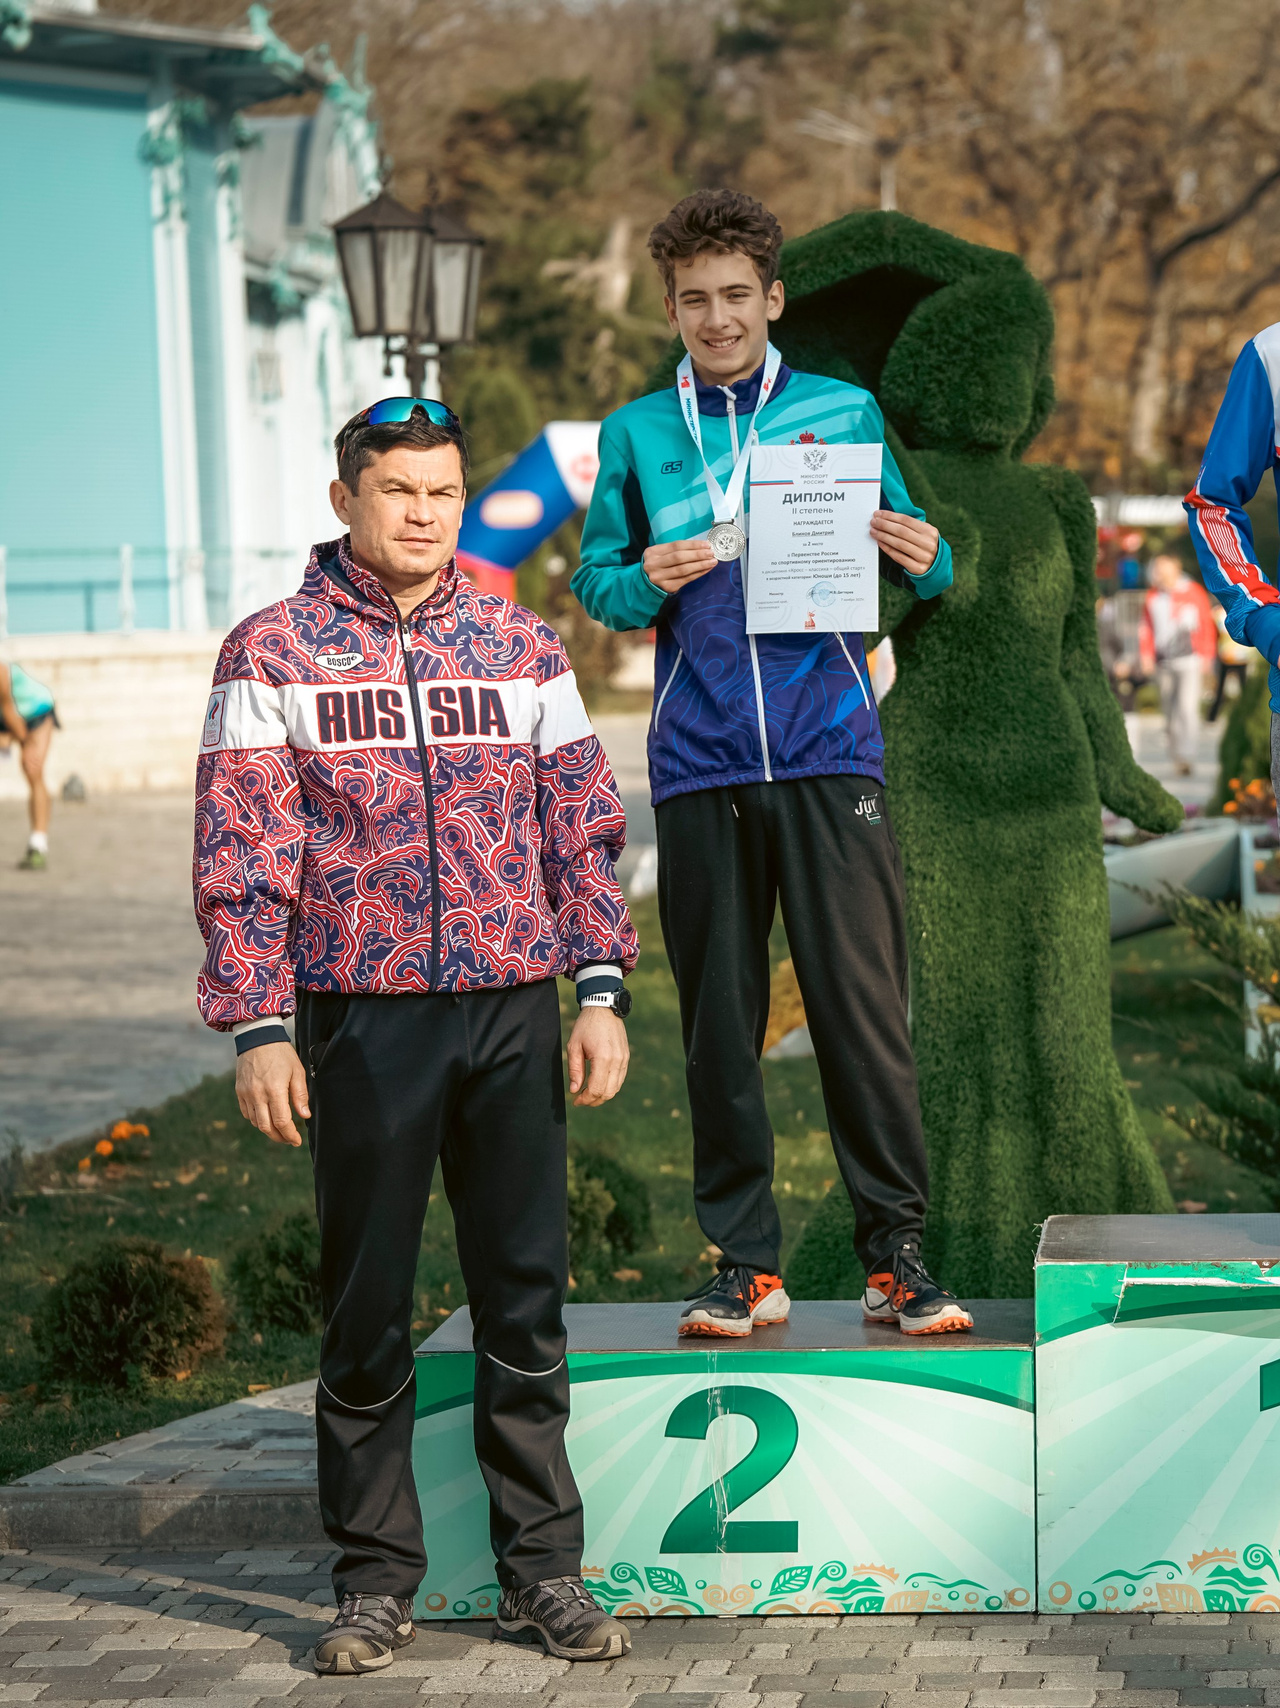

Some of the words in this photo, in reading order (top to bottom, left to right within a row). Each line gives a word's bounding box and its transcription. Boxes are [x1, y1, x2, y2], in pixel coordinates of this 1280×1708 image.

[661, 461, 683, 475] GS
[782, 491, 845, 505] ДИПЛОМ
[326, 656, 352, 667] BOSCO
[660, 1386, 799, 1554] 2
